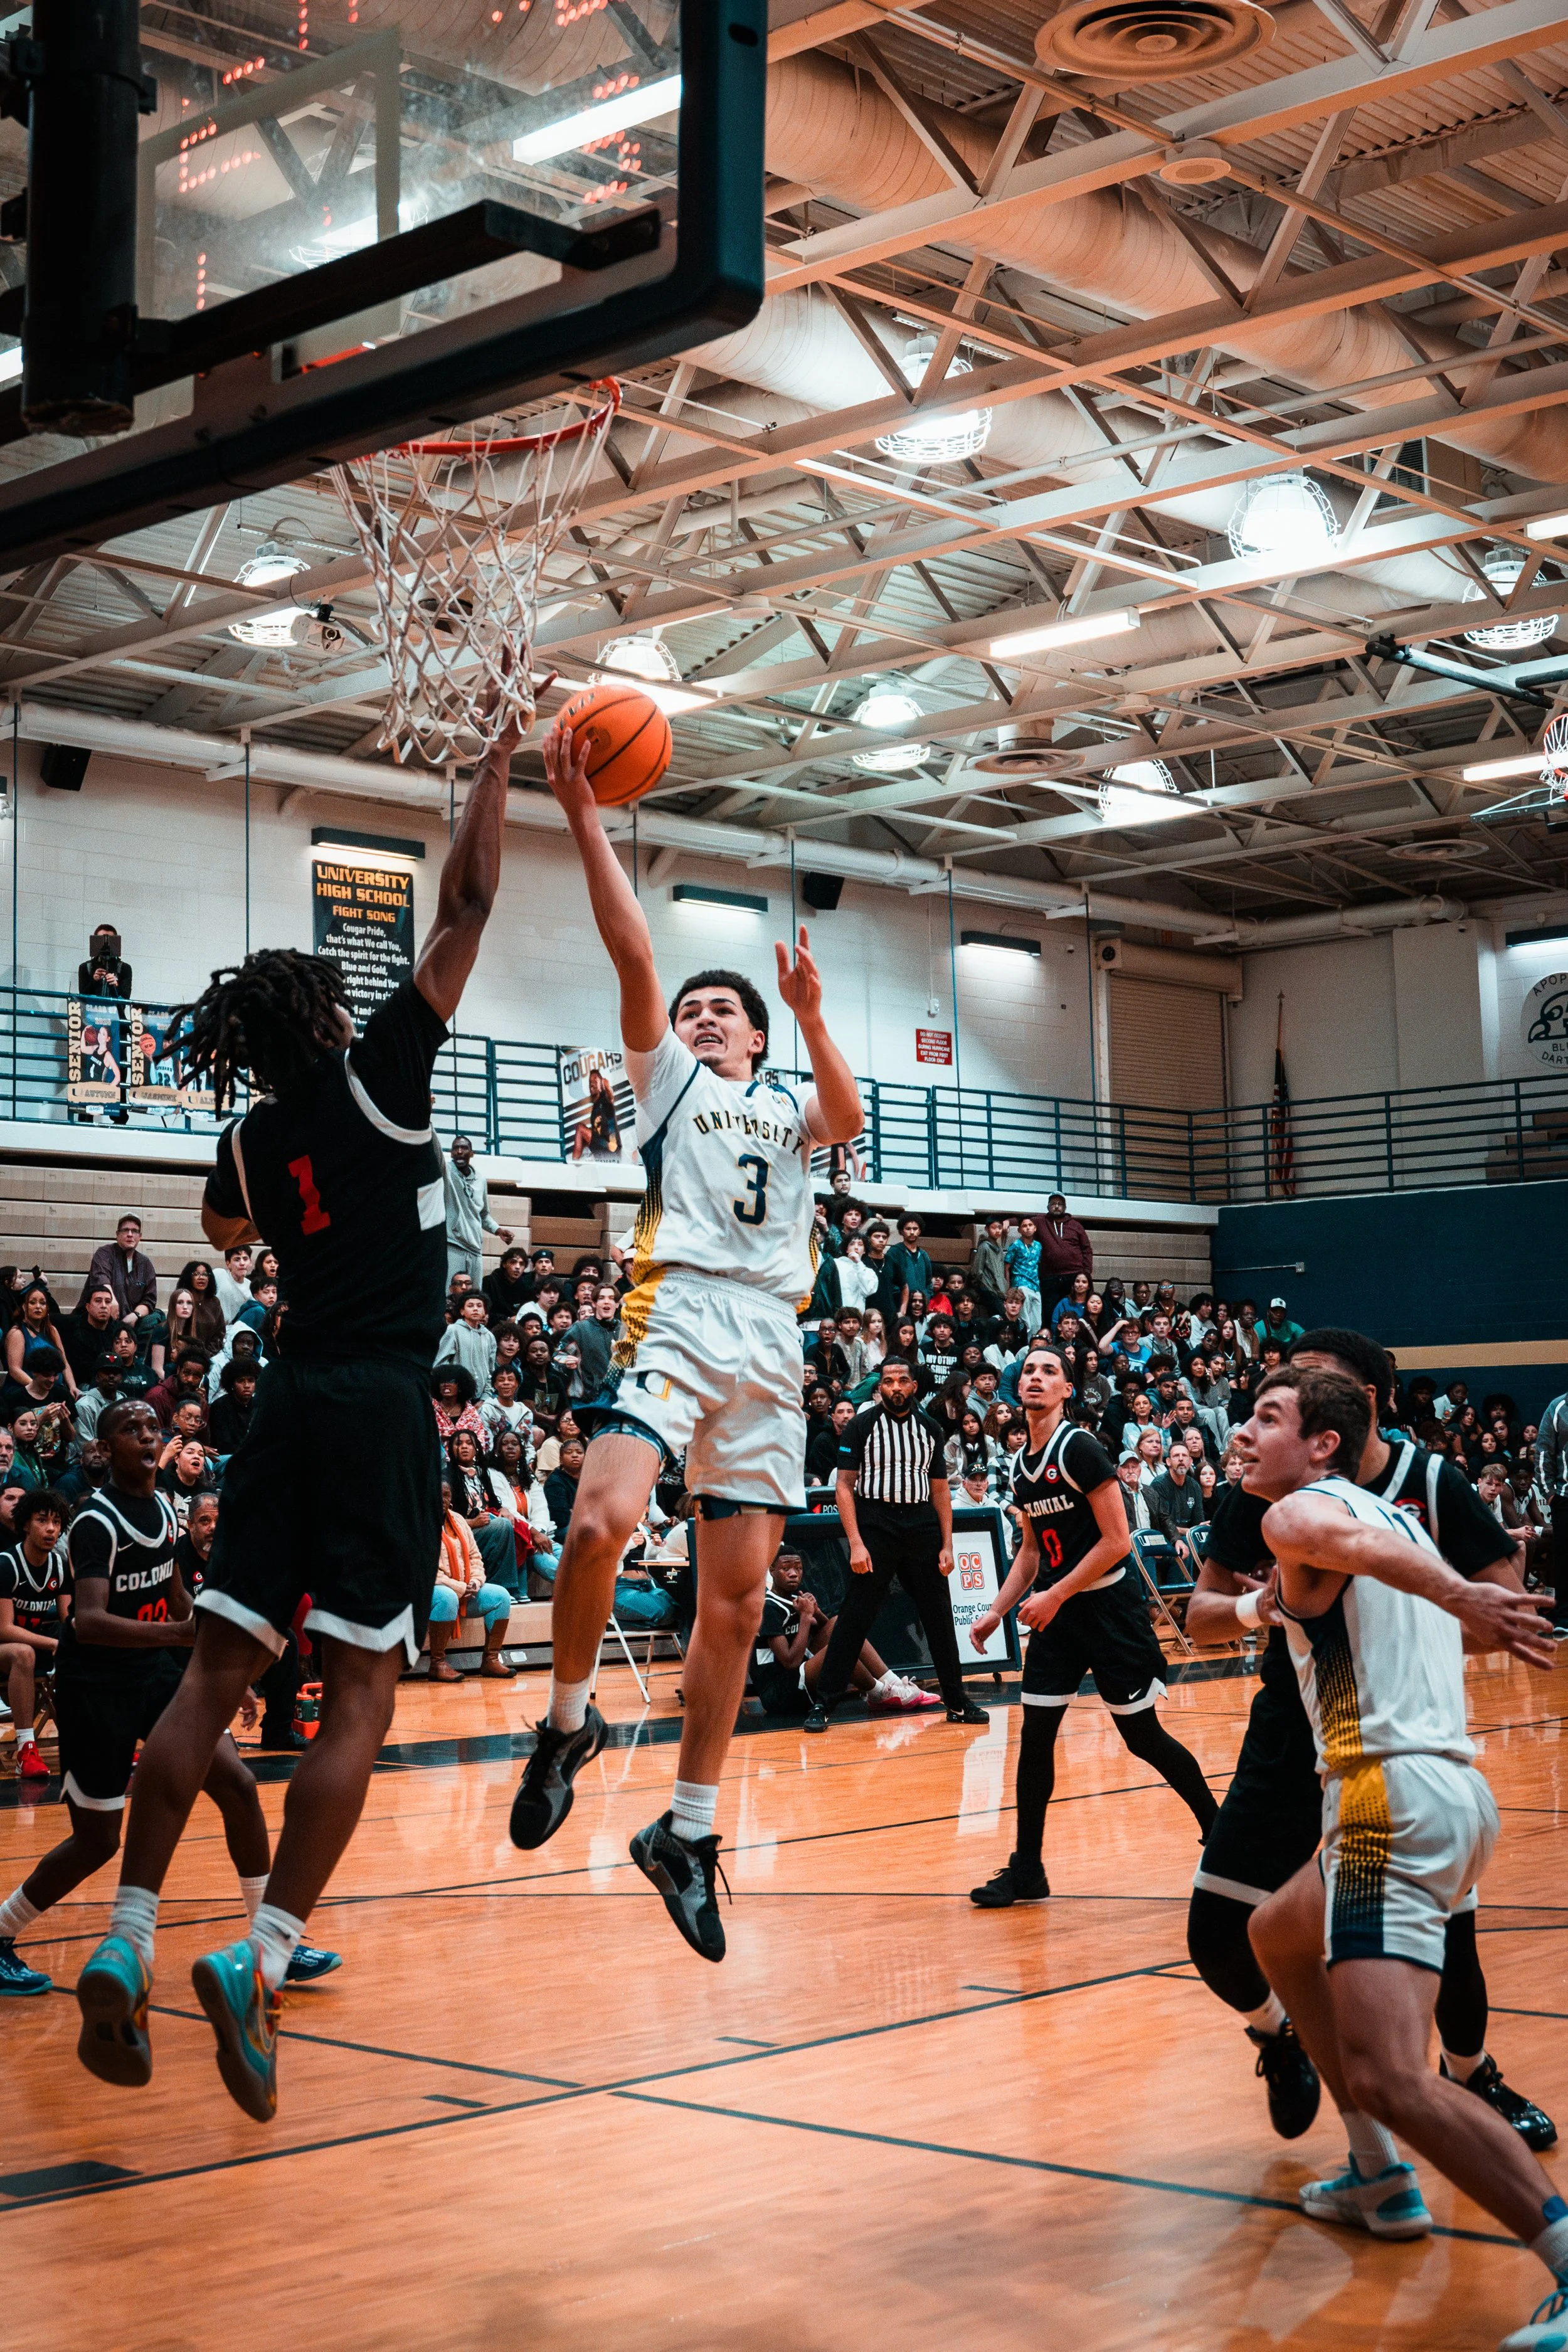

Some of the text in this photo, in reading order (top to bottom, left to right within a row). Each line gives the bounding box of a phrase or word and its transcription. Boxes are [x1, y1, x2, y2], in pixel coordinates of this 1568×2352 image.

[317, 864, 409, 890] UNIVERSITY
[317, 882, 410, 907] HIGH SCHOOL
[332, 905, 396, 923] FIGHT SONG
[343, 923, 386, 937] Cougar Pride,
[326, 934, 401, 952] that's what We call You,
[318, 946, 410, 966] Catch the spirit for the fight.
[341, 961, 388, 976] Blue and Gold,
[347, 975, 400, 988] right behind You
[352, 988, 374, 1000] victory
[376, 990, 382, 999] in
[359, 1006, 371, 1015] and
[68, 1002, 82, 1082] SENIOR
[131, 1008, 144, 1086] SENIOR
[1552, 1042, 1568, 1052] BL
[85, 1089, 116, 1099] AUTUMN
[693, 1110, 805, 1155] UNIVERSITY
[288, 1154, 331, 1236] 1
[733, 1153, 771, 1226] 3
[926, 1354, 937, 1364] MY
[1042, 1528, 1064, 1568] 0
[953, 1604, 976, 1616] Orange
[955, 1616, 973, 1626] Public
